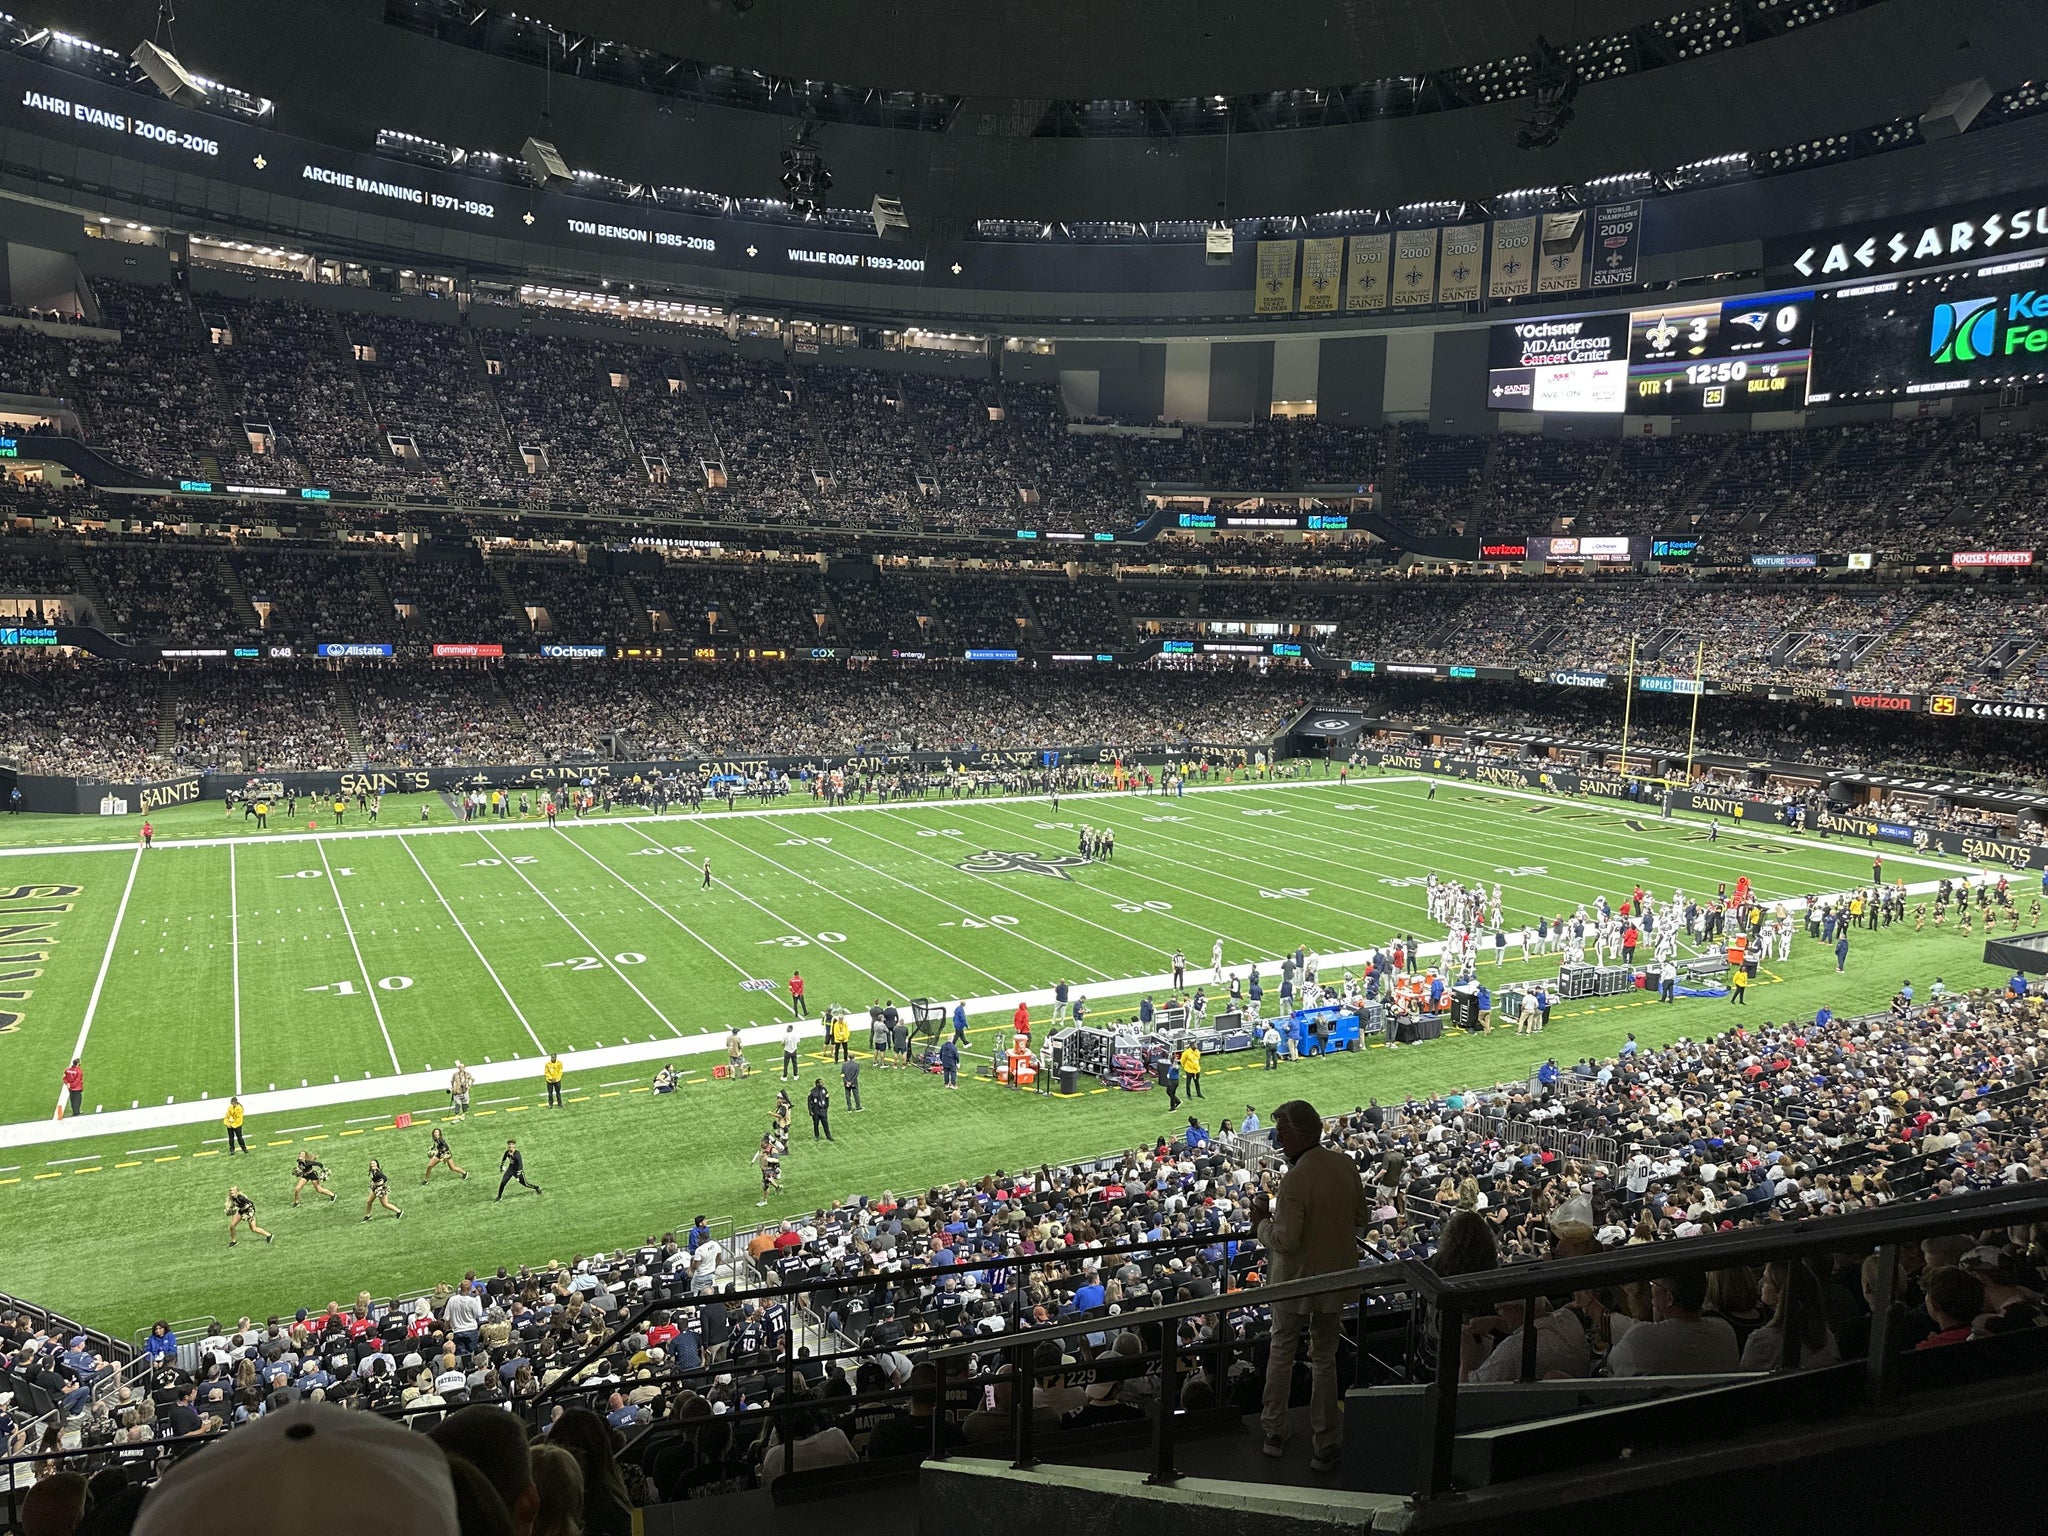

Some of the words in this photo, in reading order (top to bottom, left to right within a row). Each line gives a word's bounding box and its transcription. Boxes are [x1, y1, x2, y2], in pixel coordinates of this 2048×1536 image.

[22, 90, 71, 117] JAHRI
[74, 103, 125, 131] EVANS
[135, 119, 219, 156] 2006-2016
[303, 164, 354, 189] ARCHIE
[356, 178, 423, 203] MANNING
[430, 193, 495, 218] 1971-1982
[1598, 209, 1638, 221] CHAMPIONS
[1606, 205, 1631, 214] WORLD
[567, 219, 596, 235] TOM
[597, 224, 647, 242] BENSON
[655, 232, 716, 251] 1985-2018
[1600, 222, 1633, 236] 2009
[1498, 236, 1528, 249] 2009
[1793, 213, 2005, 277] CAESARS
[1400, 247, 1431, 259] 2000
[1447, 244, 1478, 255] 2006
[788, 249, 827, 264] WILLIE
[828, 253, 859, 267] ROAF
[866, 256, 925, 271] 1993-2001
[1355, 253, 1381, 264] 1991
[1593, 272, 1632, 285] SAINTS
[1492, 284, 1528, 296] SAINTS
[1540, 279, 1577, 291] SAINTS
[1395, 292, 1430, 303] SAINTS
[1441, 290, 1478, 302] SAINTS
[1350, 298, 1384, 309] SAINTS
[1776, 306, 1797, 333] 0
[1523, 322, 1583, 338] Ochsner
[1688, 317, 1707, 342] 3
[1522, 340, 1547, 354] MD
[1547, 336, 1610, 353] Anderson
[1521, 353, 1567, 366] Cancer
[1568, 349, 1611, 363] Center
[1686, 361, 1747, 384] 12:50
[1639, 380, 1660, 396] QTR
[1664, 379, 1672, 394] 1
[1748, 379, 1769, 392] BALL
[1770, 378, 1786, 390] ON
[1707, 391, 1721, 403] 25
[371, 493, 407, 503] SAINTS
[446, 497, 480, 507] SAINTS
[518, 501, 550, 511] SAINTS
[69, 508, 109, 519] SAINTS
[156, 513, 193, 523] SAINTS
[653, 510, 683, 519] SAINTS
[241, 517, 277, 527] SAINTS
[320, 521, 354, 530] SAINTS
[779, 518, 808, 526] SAINTS
[840, 521, 867, 529] SAINTS
[397, 525, 430, 533] SAINTS
[631, 536, 673, 546] CAESARS
[674, 539, 721, 548] SUPERDOME
[1482, 544, 1525, 555] verizon
[1882, 553, 1916, 562] SAINTS
[1953, 554, 1986, 564] ROUSES
[1988, 553, 2030, 564] MARKETS
[20, 628, 57, 637] Keesler
[20, 636, 57, 645] Federal
[270, 647, 291, 657] 0:48
[397, 645, 430, 653] SAINTS
[437, 645, 478, 656] Community
[551, 646, 604, 657] Ochsner
[695, 649, 715, 658] 12:50
[811, 649, 835, 658] COX
[900, 651, 925, 659] entergy
[1556, 673, 1606, 687] Ochsner
[1641, 679, 1672, 690] PEOPLES
[1720, 683, 1752, 692] SAINTS
[1793, 688, 1827, 698] SAINTS
[1852, 692, 1911, 710] verizon
[1933, 698, 1953, 712] 25
[1971, 703, 2045, 720] CAESARS
[1465, 730, 1569, 744] CAESARS
[1382, 754, 1421, 769] SAINTS
[530, 765, 610, 779] SAINTS
[1962, 838, 2031, 863] SAINTS
[1110, 900, 1174, 914] 50
[960, 914, 1020, 930] 40
[774, 931, 848, 948] 30
[565, 952, 647, 971] 20
[331, 976, 414, 997] 10
[1638, 1166, 1648, 1178] 10
[644, 1254, 654, 1264] 7
[992, 1268, 1006, 1286] 11
[771, 1315, 785, 1332] 11
[743, 1338, 757, 1349] 10
[437, 1376, 464, 1386] PATRIOTS
[1066, 1369, 1097, 1386] 229
